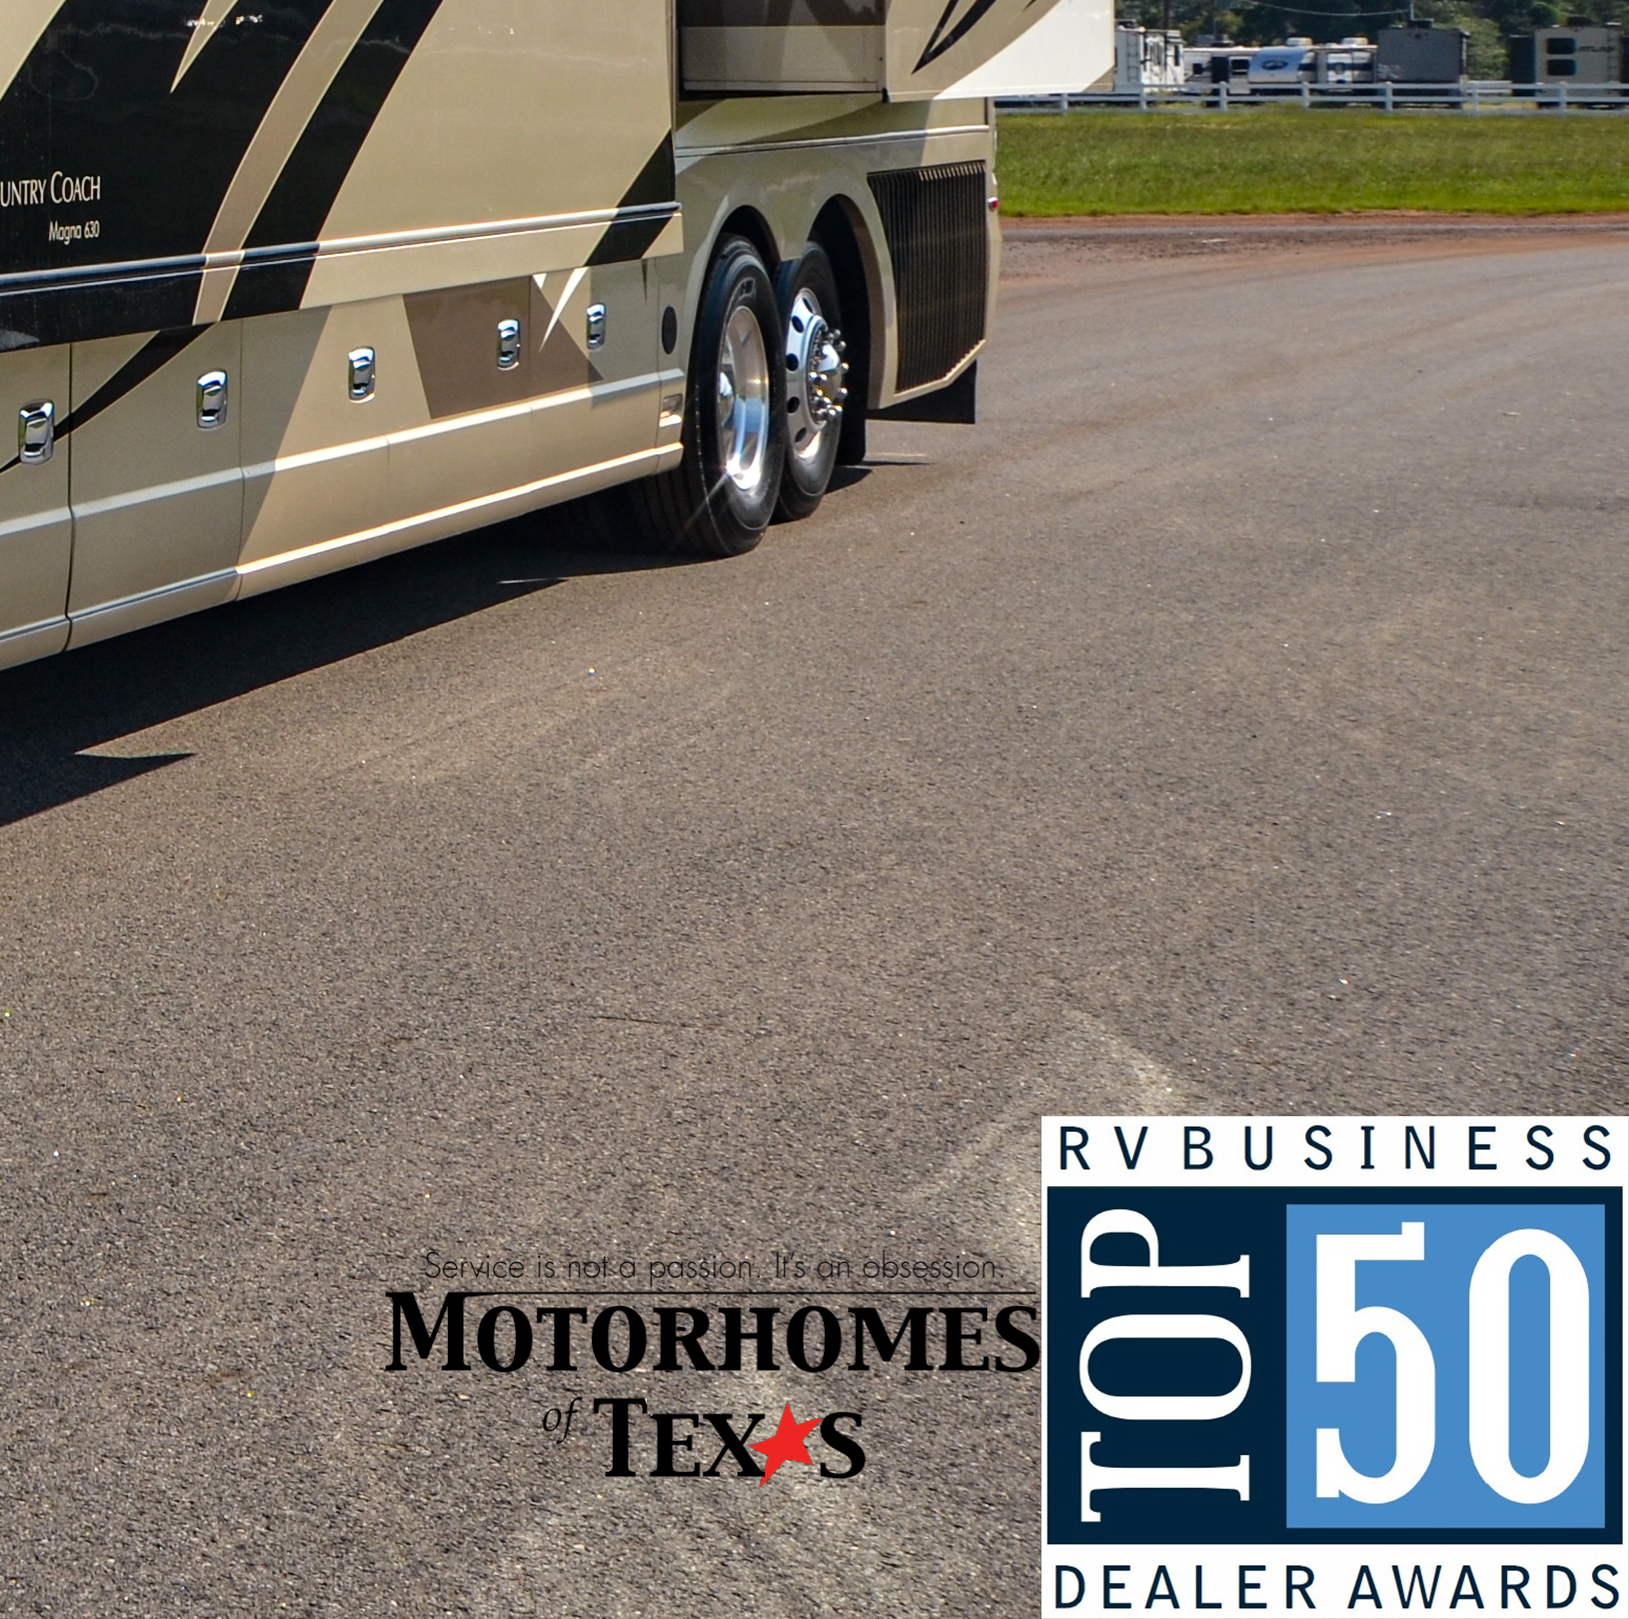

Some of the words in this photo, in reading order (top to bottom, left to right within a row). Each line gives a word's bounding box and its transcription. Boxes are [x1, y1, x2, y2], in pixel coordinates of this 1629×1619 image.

[50, 170, 101, 204] COACH
[48, 220, 82, 245] Magna
[83, 220, 100, 239] 630
